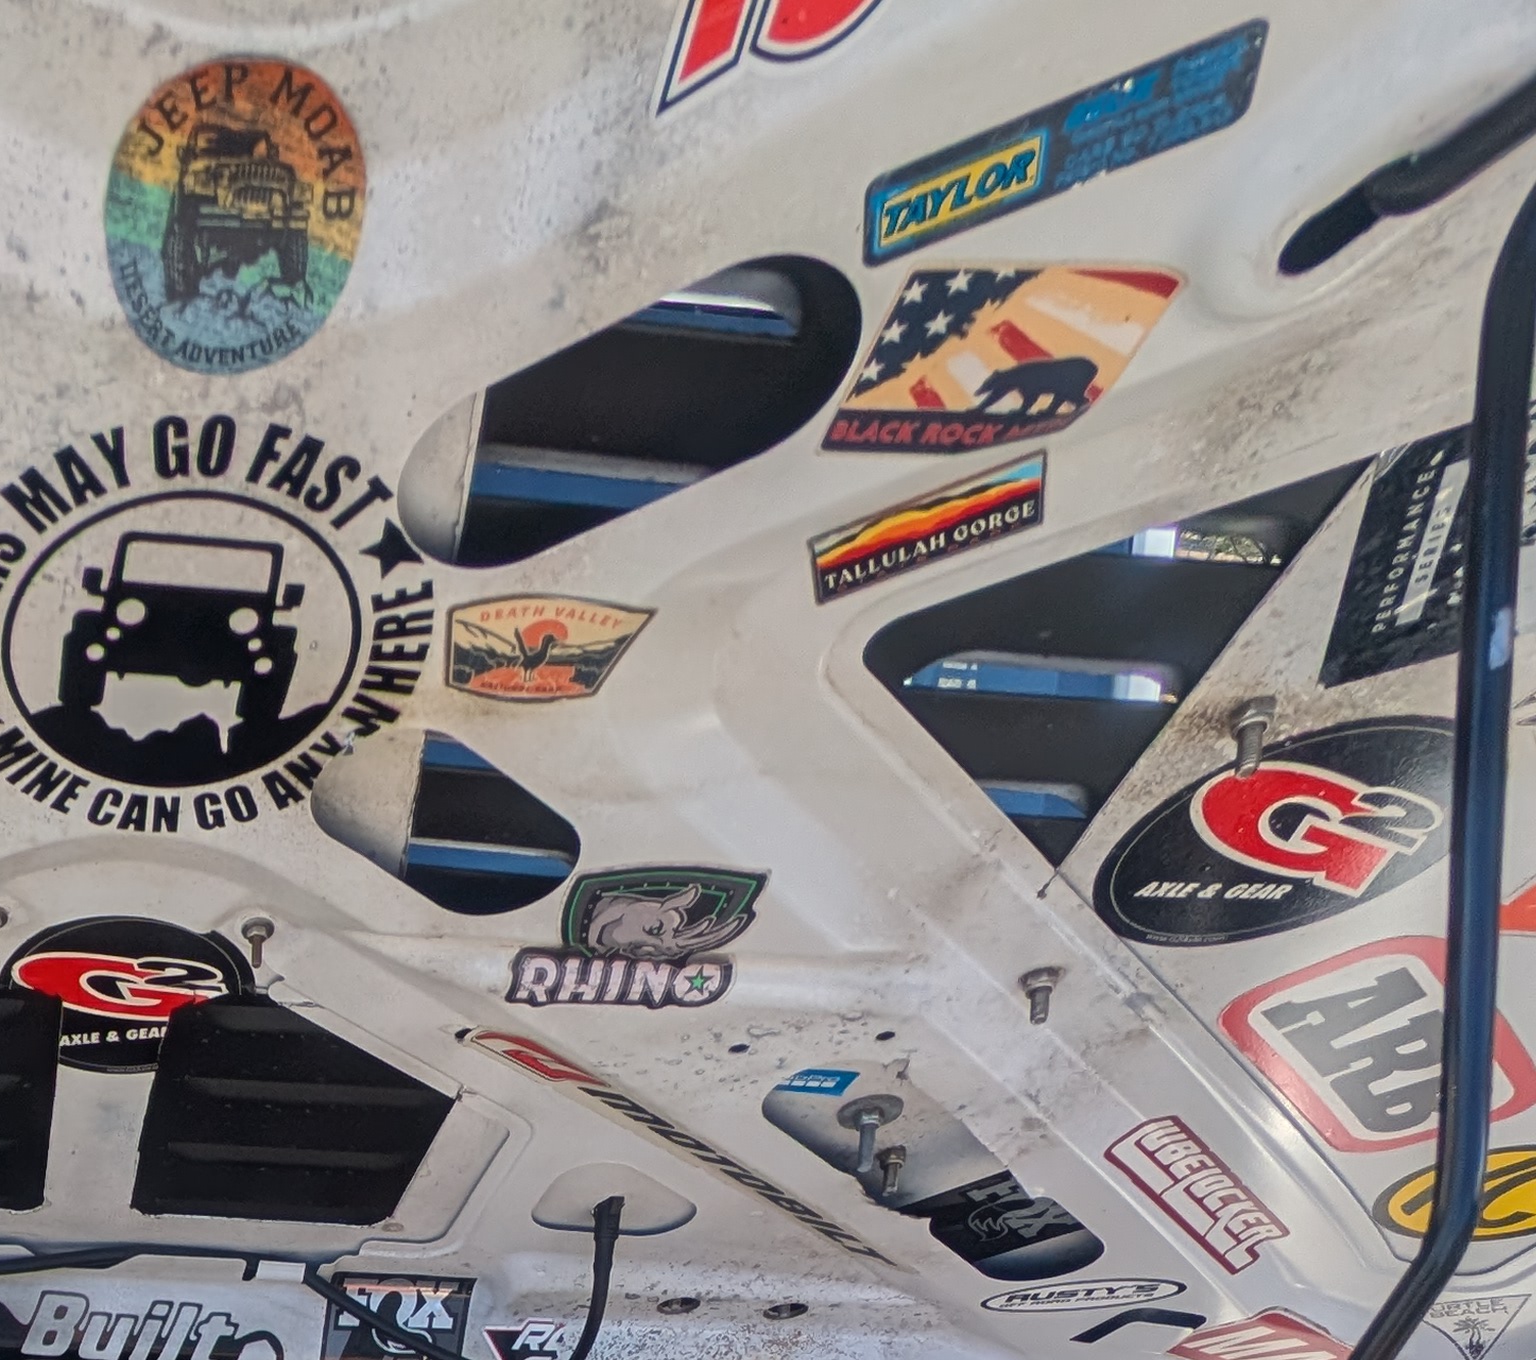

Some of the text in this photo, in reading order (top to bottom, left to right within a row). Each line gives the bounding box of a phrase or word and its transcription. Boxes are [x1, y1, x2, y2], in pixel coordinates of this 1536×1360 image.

[136, 64, 358, 220] JEEP MOAB
[883, 149, 1037, 241] TAYLOR
[175, 320, 303, 368] ADVENTURE
[830, 419, 918, 445] BLACK
[919, 421, 1002, 446] ROCK
[0, 426, 132, 534] MAY
[152, 414, 237, 478] GO
[246, 422, 395, 531] FAST
[823, 530, 947, 591] TALLULAH
[952, 499, 1037, 544] GORGE
[1370, 468, 1437, 634] PERFORMANCE
[1414, 506, 1452, 584] SERIES
[480, 605, 623, 630] DEATH VALLEY
[86, 786, 181, 834] CAN
[192, 784, 260, 829] GO
[1133, 880, 1295, 901] AXLE & GEAR
[514, 955, 722, 1003] RHINO
[59, 1032, 101, 1047] AXLE
[106, 1030, 120, 1043] &
[577, 1086, 897, 1266] MOTOBILT
[1004, 1282, 1162, 1304] RUSTY'S
